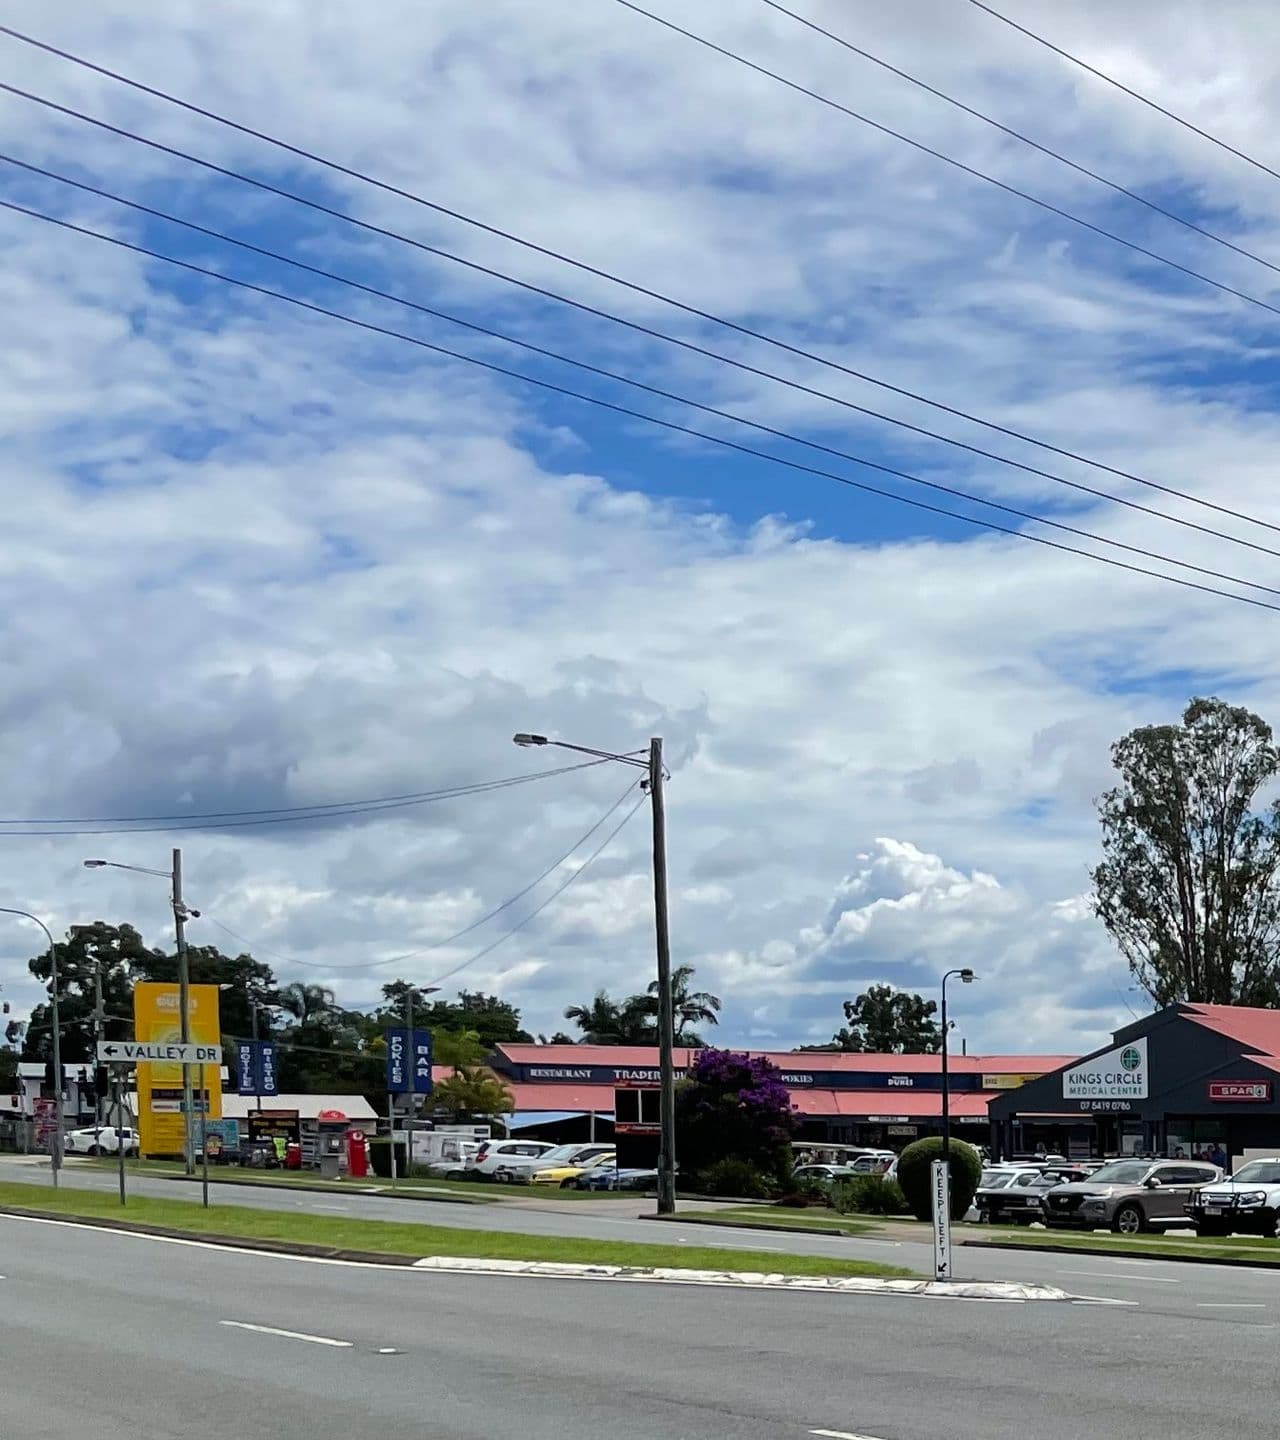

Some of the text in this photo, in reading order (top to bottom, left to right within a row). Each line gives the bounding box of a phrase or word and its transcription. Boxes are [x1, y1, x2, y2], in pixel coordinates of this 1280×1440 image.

[124, 1045, 217, 1061] VALLEY DR
[391, 1036, 402, 1084] POKIES
[240, 1046, 252, 1087] BOTTLE
[417, 1045, 429, 1077] BAR
[263, 1047, 275, 1091] BISTRO
[530, 1068, 592, 1079] RESTAURANT
[781, 1073, 814, 1084] POKIES
[1069, 1073, 1142, 1085] KINGS CIRCLE
[1069, 1086, 1142, 1096] MEDICAL CENTRE
[1221, 1086, 1254, 1096] SPAR
[1080, 1102, 1090, 1111] 07
[936, 1168, 944, 1209] KEEP
